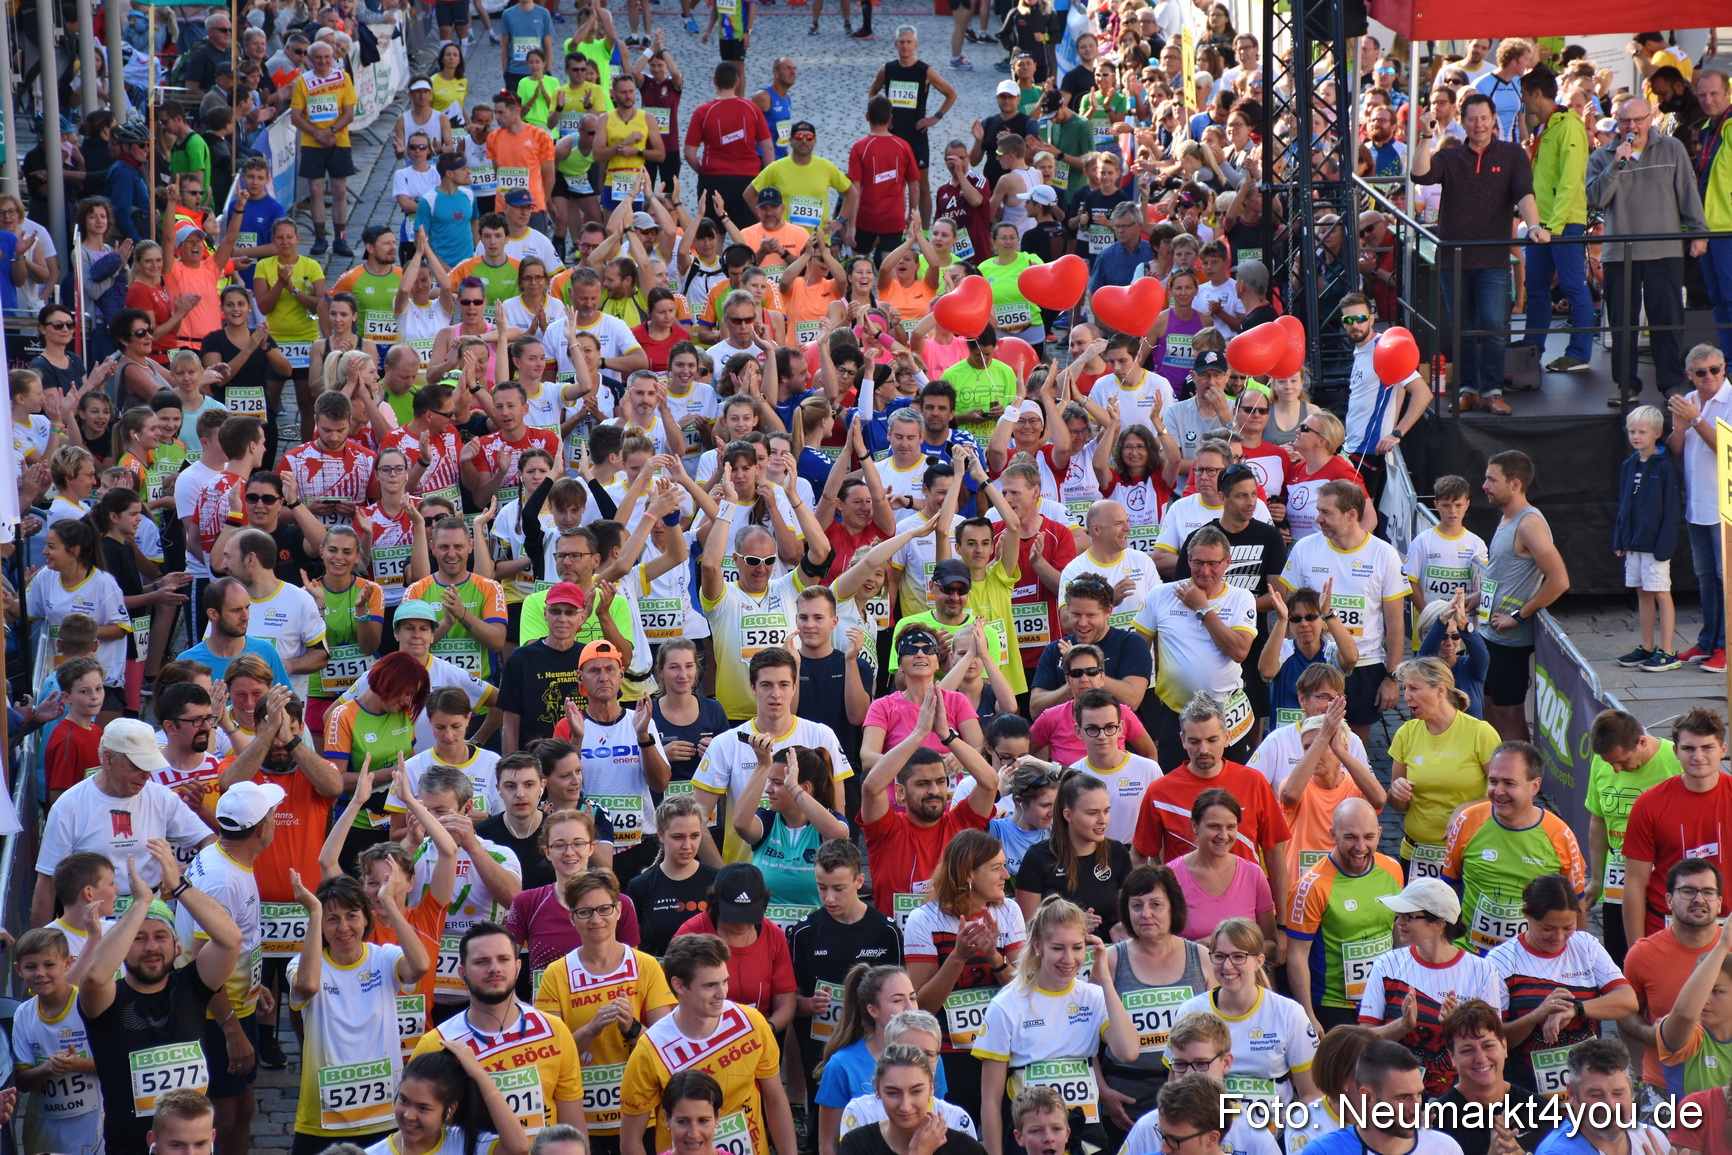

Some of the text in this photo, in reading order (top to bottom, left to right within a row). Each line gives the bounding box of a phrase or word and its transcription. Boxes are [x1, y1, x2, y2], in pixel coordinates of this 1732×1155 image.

[515, 45, 536, 53] 259
[892, 90, 915, 99] 1126
[310, 105, 334, 113] 2842
[472, 173, 497, 183] 2183
[500, 177, 526, 187] 1019
[792, 205, 819, 218] 2831
[764, 265, 786, 274] OCK
[997, 312, 1030, 326] 5056
[369, 324, 397, 334] 5142
[1168, 335, 1192, 345] BOC
[1170, 345, 1191, 356] 211
[229, 387, 261, 397] BOCK
[230, 400, 262, 411] 5128
[1128, 528, 1160, 538] OCK
[1429, 567, 1467, 579] BOCK
[1331, 597, 1358, 608] OCK
[1012, 605, 1044, 617] OCK
[640, 613, 676, 627] 5267
[742, 614, 785, 627] BOCK
[1339, 611, 1358, 625] 38
[1014, 618, 1043, 633] 189
[1018, 635, 1041, 643] OMAS
[326, 659, 368, 677] 5151
[446, 655, 475, 670] 152
[545, 671, 578, 680] Neumark
[613, 813, 638, 830] 48
[613, 832, 638, 841] GANG
[1414, 846, 1449, 860] BOC
[1416, 863, 1441, 878] 50
[1293, 873, 1321, 926] BOCK
[445, 920, 476, 930] ERGIE
[571, 991, 603, 1008] MAX
[1127, 990, 1182, 1009] BOCK
[1131, 1010, 1174, 1032] 501
[1139, 1035, 1169, 1045] CHRIS
[1250, 1030, 1263, 1040] 20
[1249, 1038, 1281, 1046] Neumarkter
[139, 1044, 196, 1066] BOCK
[512, 1044, 562, 1068] BÖGL
[717, 1038, 763, 1070] BÖGL
[324, 1061, 384, 1084] BOCK
[1030, 1062, 1085, 1077] BOCK
[142, 1064, 200, 1094] 5277
[495, 1069, 534, 1088] OCK
[1226, 1078, 1269, 1093] OCK
[328, 1080, 387, 1109] 5273
[582, 1088, 622, 1108] 509
[43, 1098, 84, 1112] MARLON
[505, 1091, 533, 1114] 01
[596, 1113, 621, 1122] LYDI
